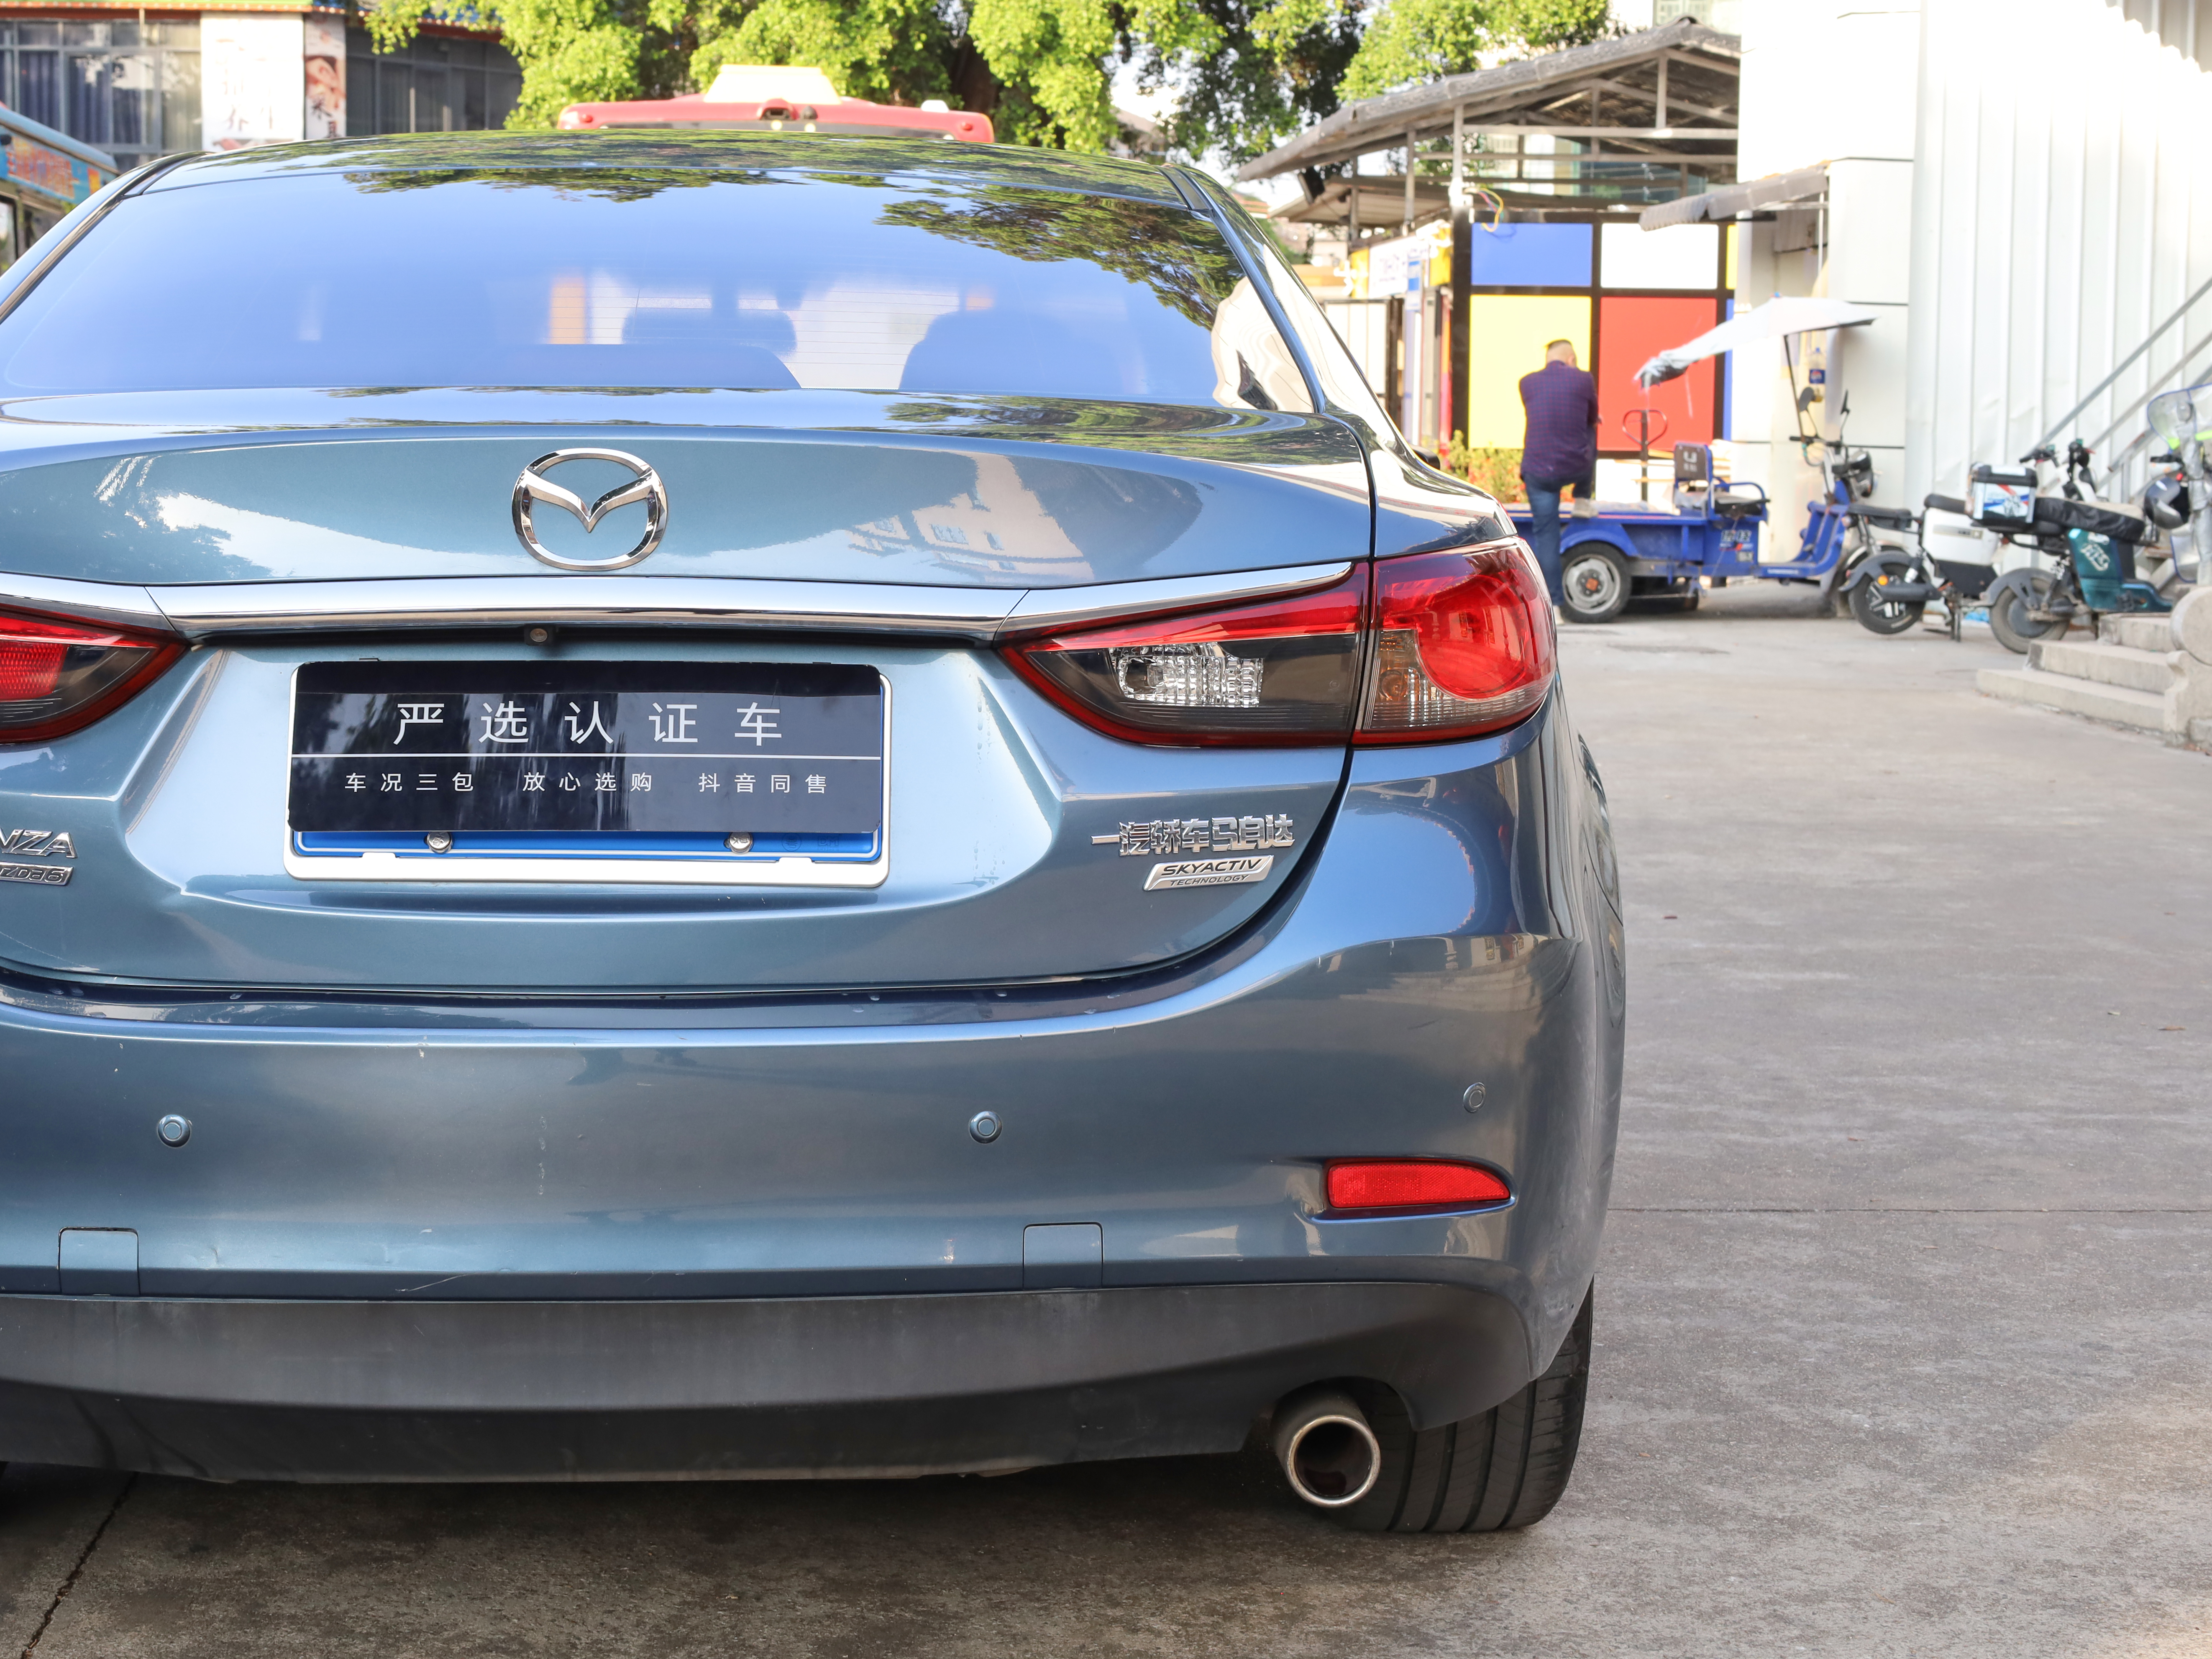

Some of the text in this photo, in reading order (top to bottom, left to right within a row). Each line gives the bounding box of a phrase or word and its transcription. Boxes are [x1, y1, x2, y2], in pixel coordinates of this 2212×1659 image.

[393, 701, 782, 746] 严选认证车
[345, 772, 827, 794] 车况三包 放心选购 抖音同售
[1161, 858, 1263, 876] SKYACTIV
[1170, 874, 1250, 886] TECHNOLOGY
